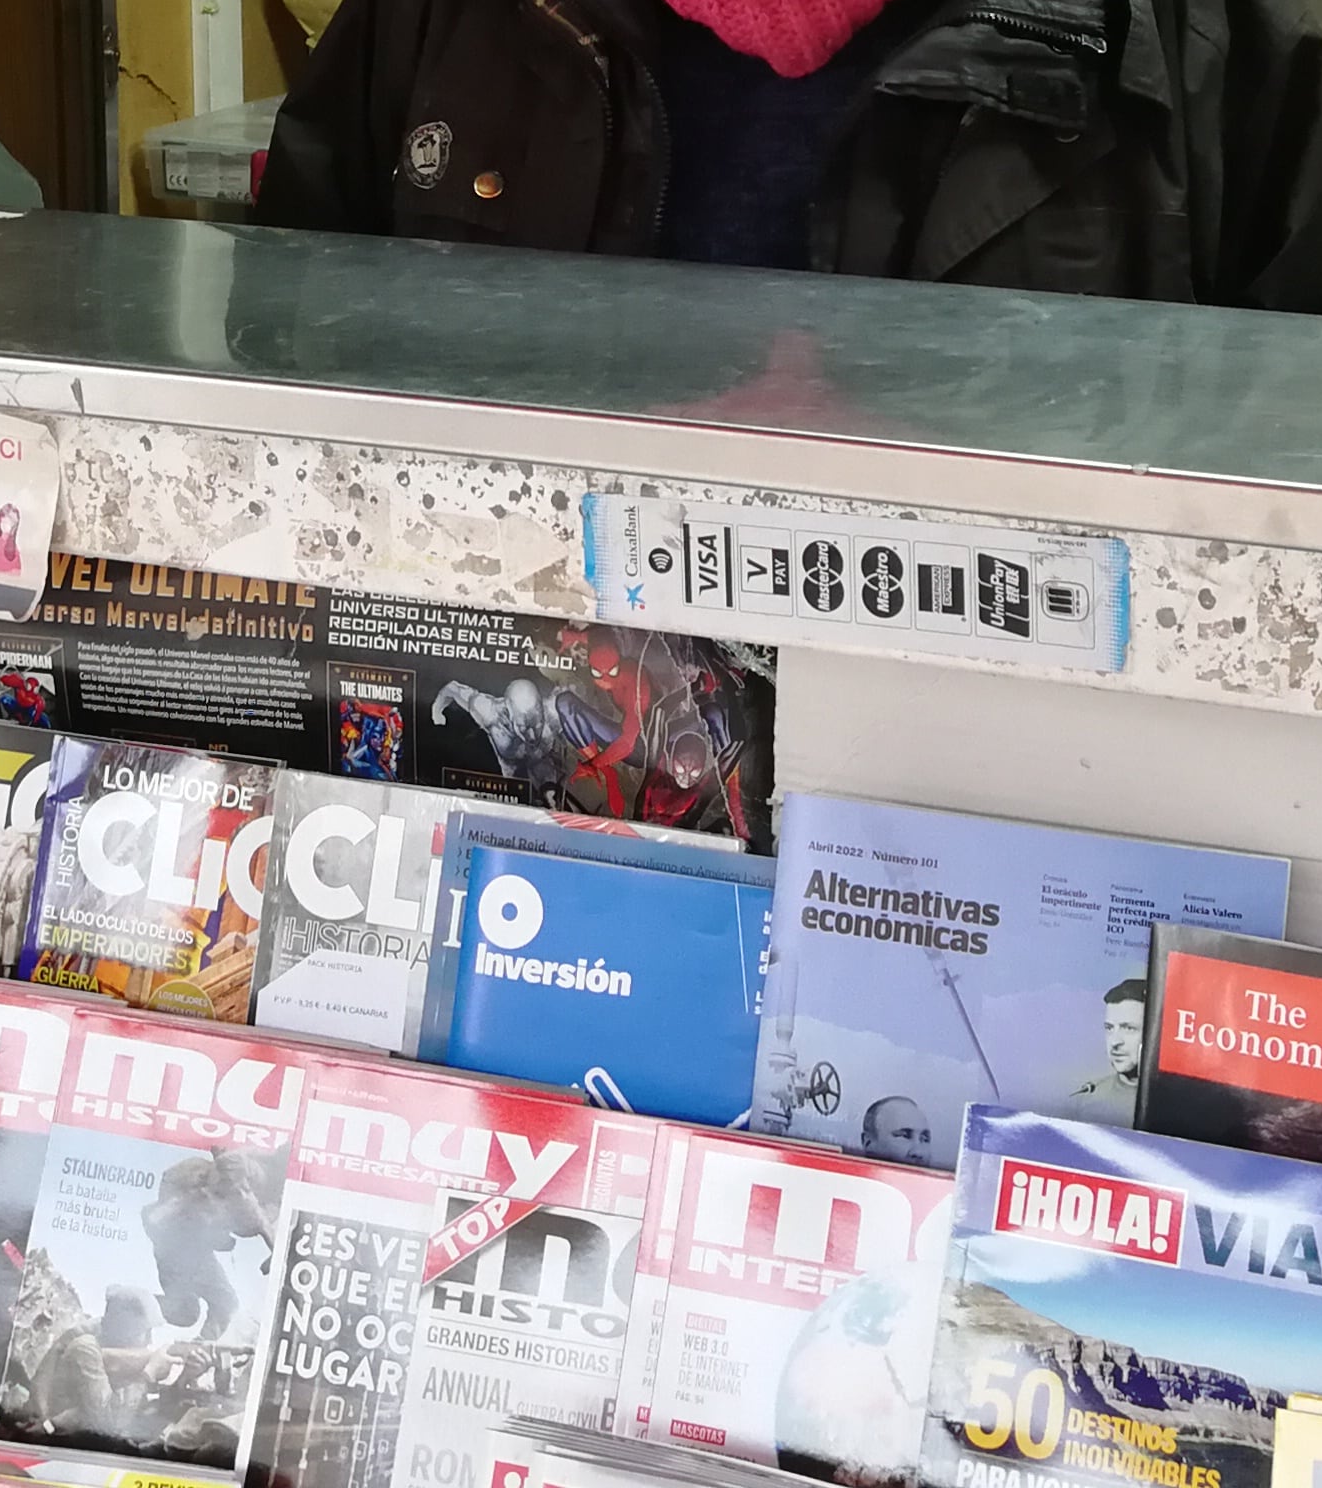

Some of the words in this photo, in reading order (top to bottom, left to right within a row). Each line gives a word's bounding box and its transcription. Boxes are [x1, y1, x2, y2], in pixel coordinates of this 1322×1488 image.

[623, 504, 638, 577] CaixaBank
[697, 533, 719, 593] VISA
[775, 557, 788, 587] PAY
[816, 540, 831, 613] MasterCard
[990, 558, 1005, 629] UnionPay
[328, 615, 452, 641] RECOPILADAS
[457, 630, 481, 644] EN
[486, 632, 535, 650] ESTA
[330, 599, 420, 621] UNIVERSO
[423, 608, 515, 630] ULTIMATE
[328, 632, 399, 652] EDICIÓN
[403, 640, 491, 661] INTEGRAL
[495, 650, 520, 664] DE
[523, 653, 577, 671] LUJO.
[103, 765, 135, 792] LO
[138, 768, 218, 805] MEJOR
[222, 783, 255, 812] DE
[57, 795, 84, 889] HISTORIA
[808, 840, 834, 854] Abril
[835, 846, 864, 859] 2022
[872, 849, 919, 867] Número
[920, 856, 939, 869] 101
[803, 869, 1001, 928] Alternativas
[1110, 893, 1155, 909] Tormenta
[801, 905, 989, 955] económicas
[476, 943, 632, 997] Inversión
[1245, 988, 1307, 1030] The
[62, 1157, 155, 1190] STALINGRADO
[297, 1147, 504, 1196] INTERESANTE
[431, 1197, 512, 1262] TOP
[1010, 1169, 1173, 1255] ¡HOLA!
[290, 1261, 371, 1305] QUE
[427, 1325, 509, 1357] GRANDES
[515, 1335, 609, 1375] HISTORIAS
[422, 1366, 514, 1416] ANNUAL
[963, 1360, 1067, 1459] 50
[1067, 1409, 1177, 1455] DESTINOS
[671, 1422, 726, 1445] MASCOTAS
[1062, 1439, 1222, 1488] INOLVIDABLES
